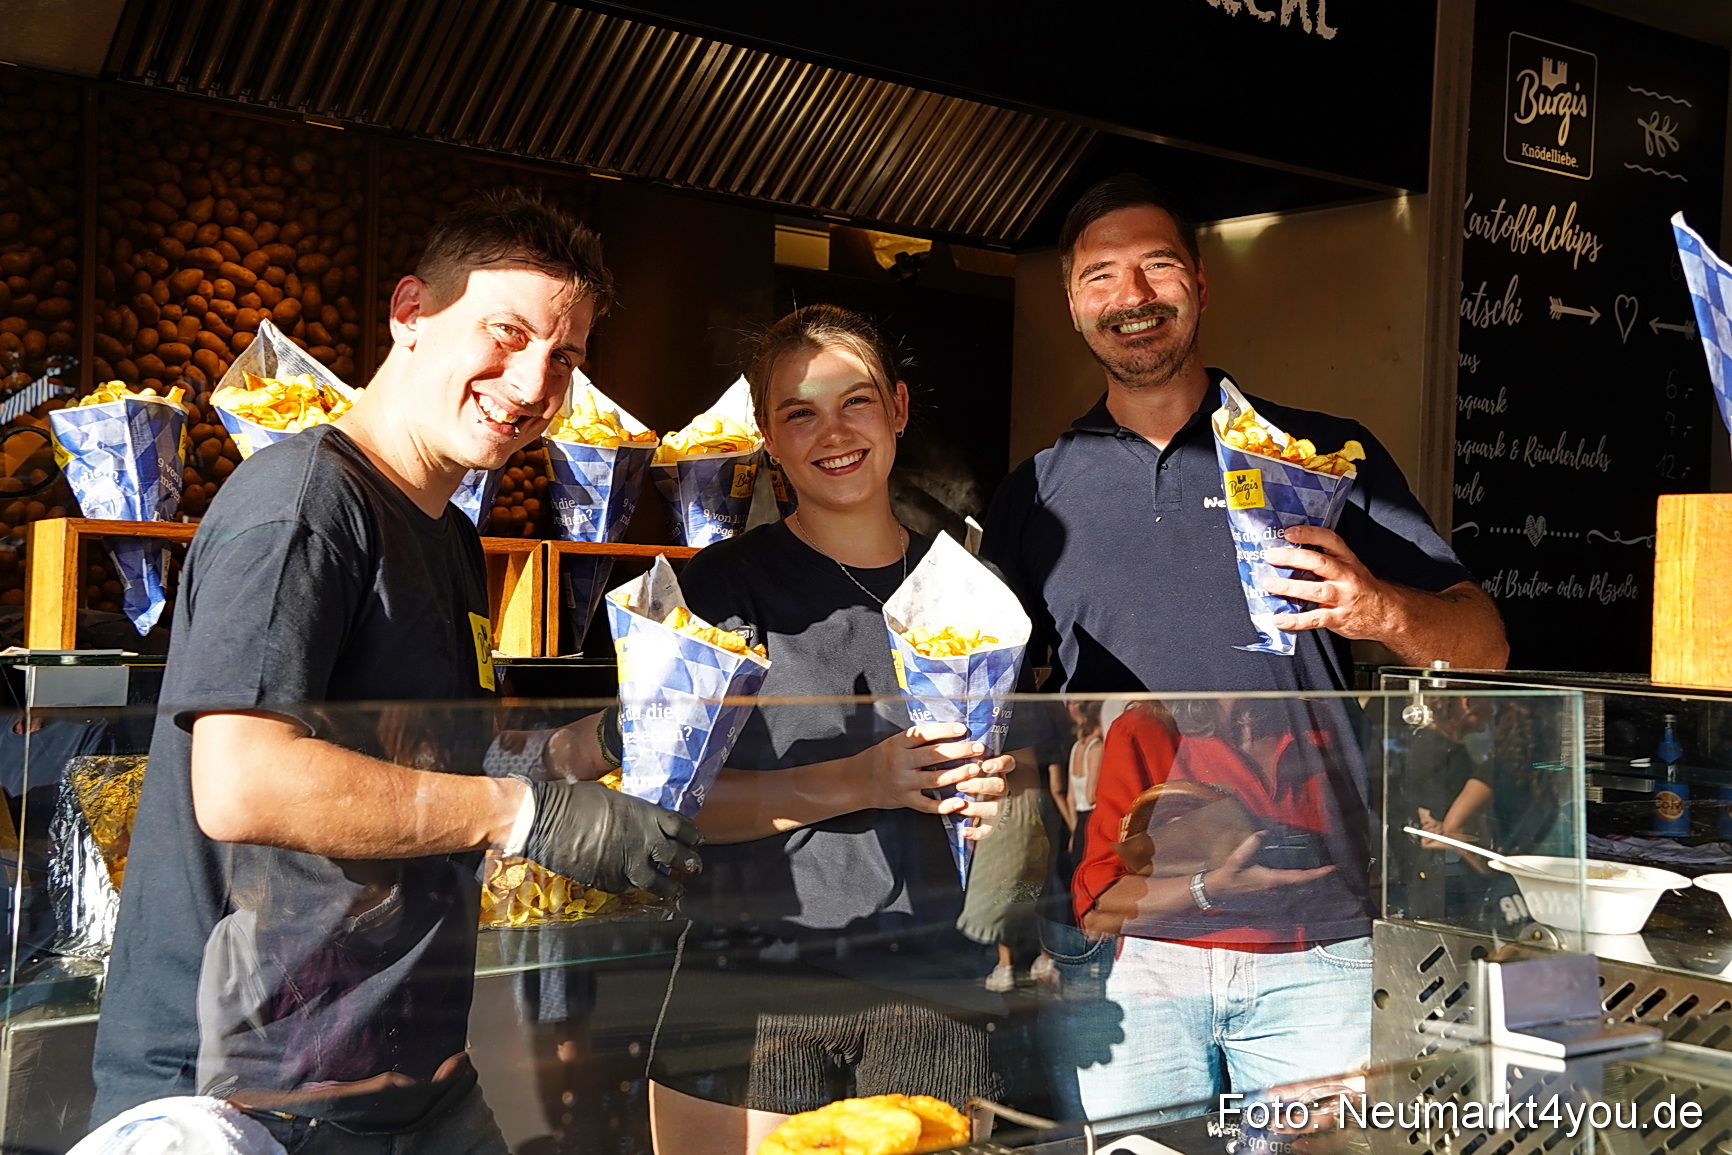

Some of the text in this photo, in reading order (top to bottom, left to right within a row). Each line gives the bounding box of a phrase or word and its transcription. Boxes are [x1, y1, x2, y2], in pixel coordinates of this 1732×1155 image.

[1513, 69, 1587, 147] Burgis
[1460, 274, 1523, 329] atschi
[1456, 386, 1508, 420] rquark
[1455, 430, 1611, 473] rquark & Räucherlachs
[1227, 479, 1259, 501] Burgis
[703, 508, 710, 518] 9
[712, 512, 731, 523] von
[1263, 526, 1285, 541] die
[1481, 569, 1504, 599] mit
[1505, 569, 1554, 599] Braten-
[1556, 574, 1587, 599] oder
[646, 702, 673, 720] die
[991, 706, 1000, 718] 9
